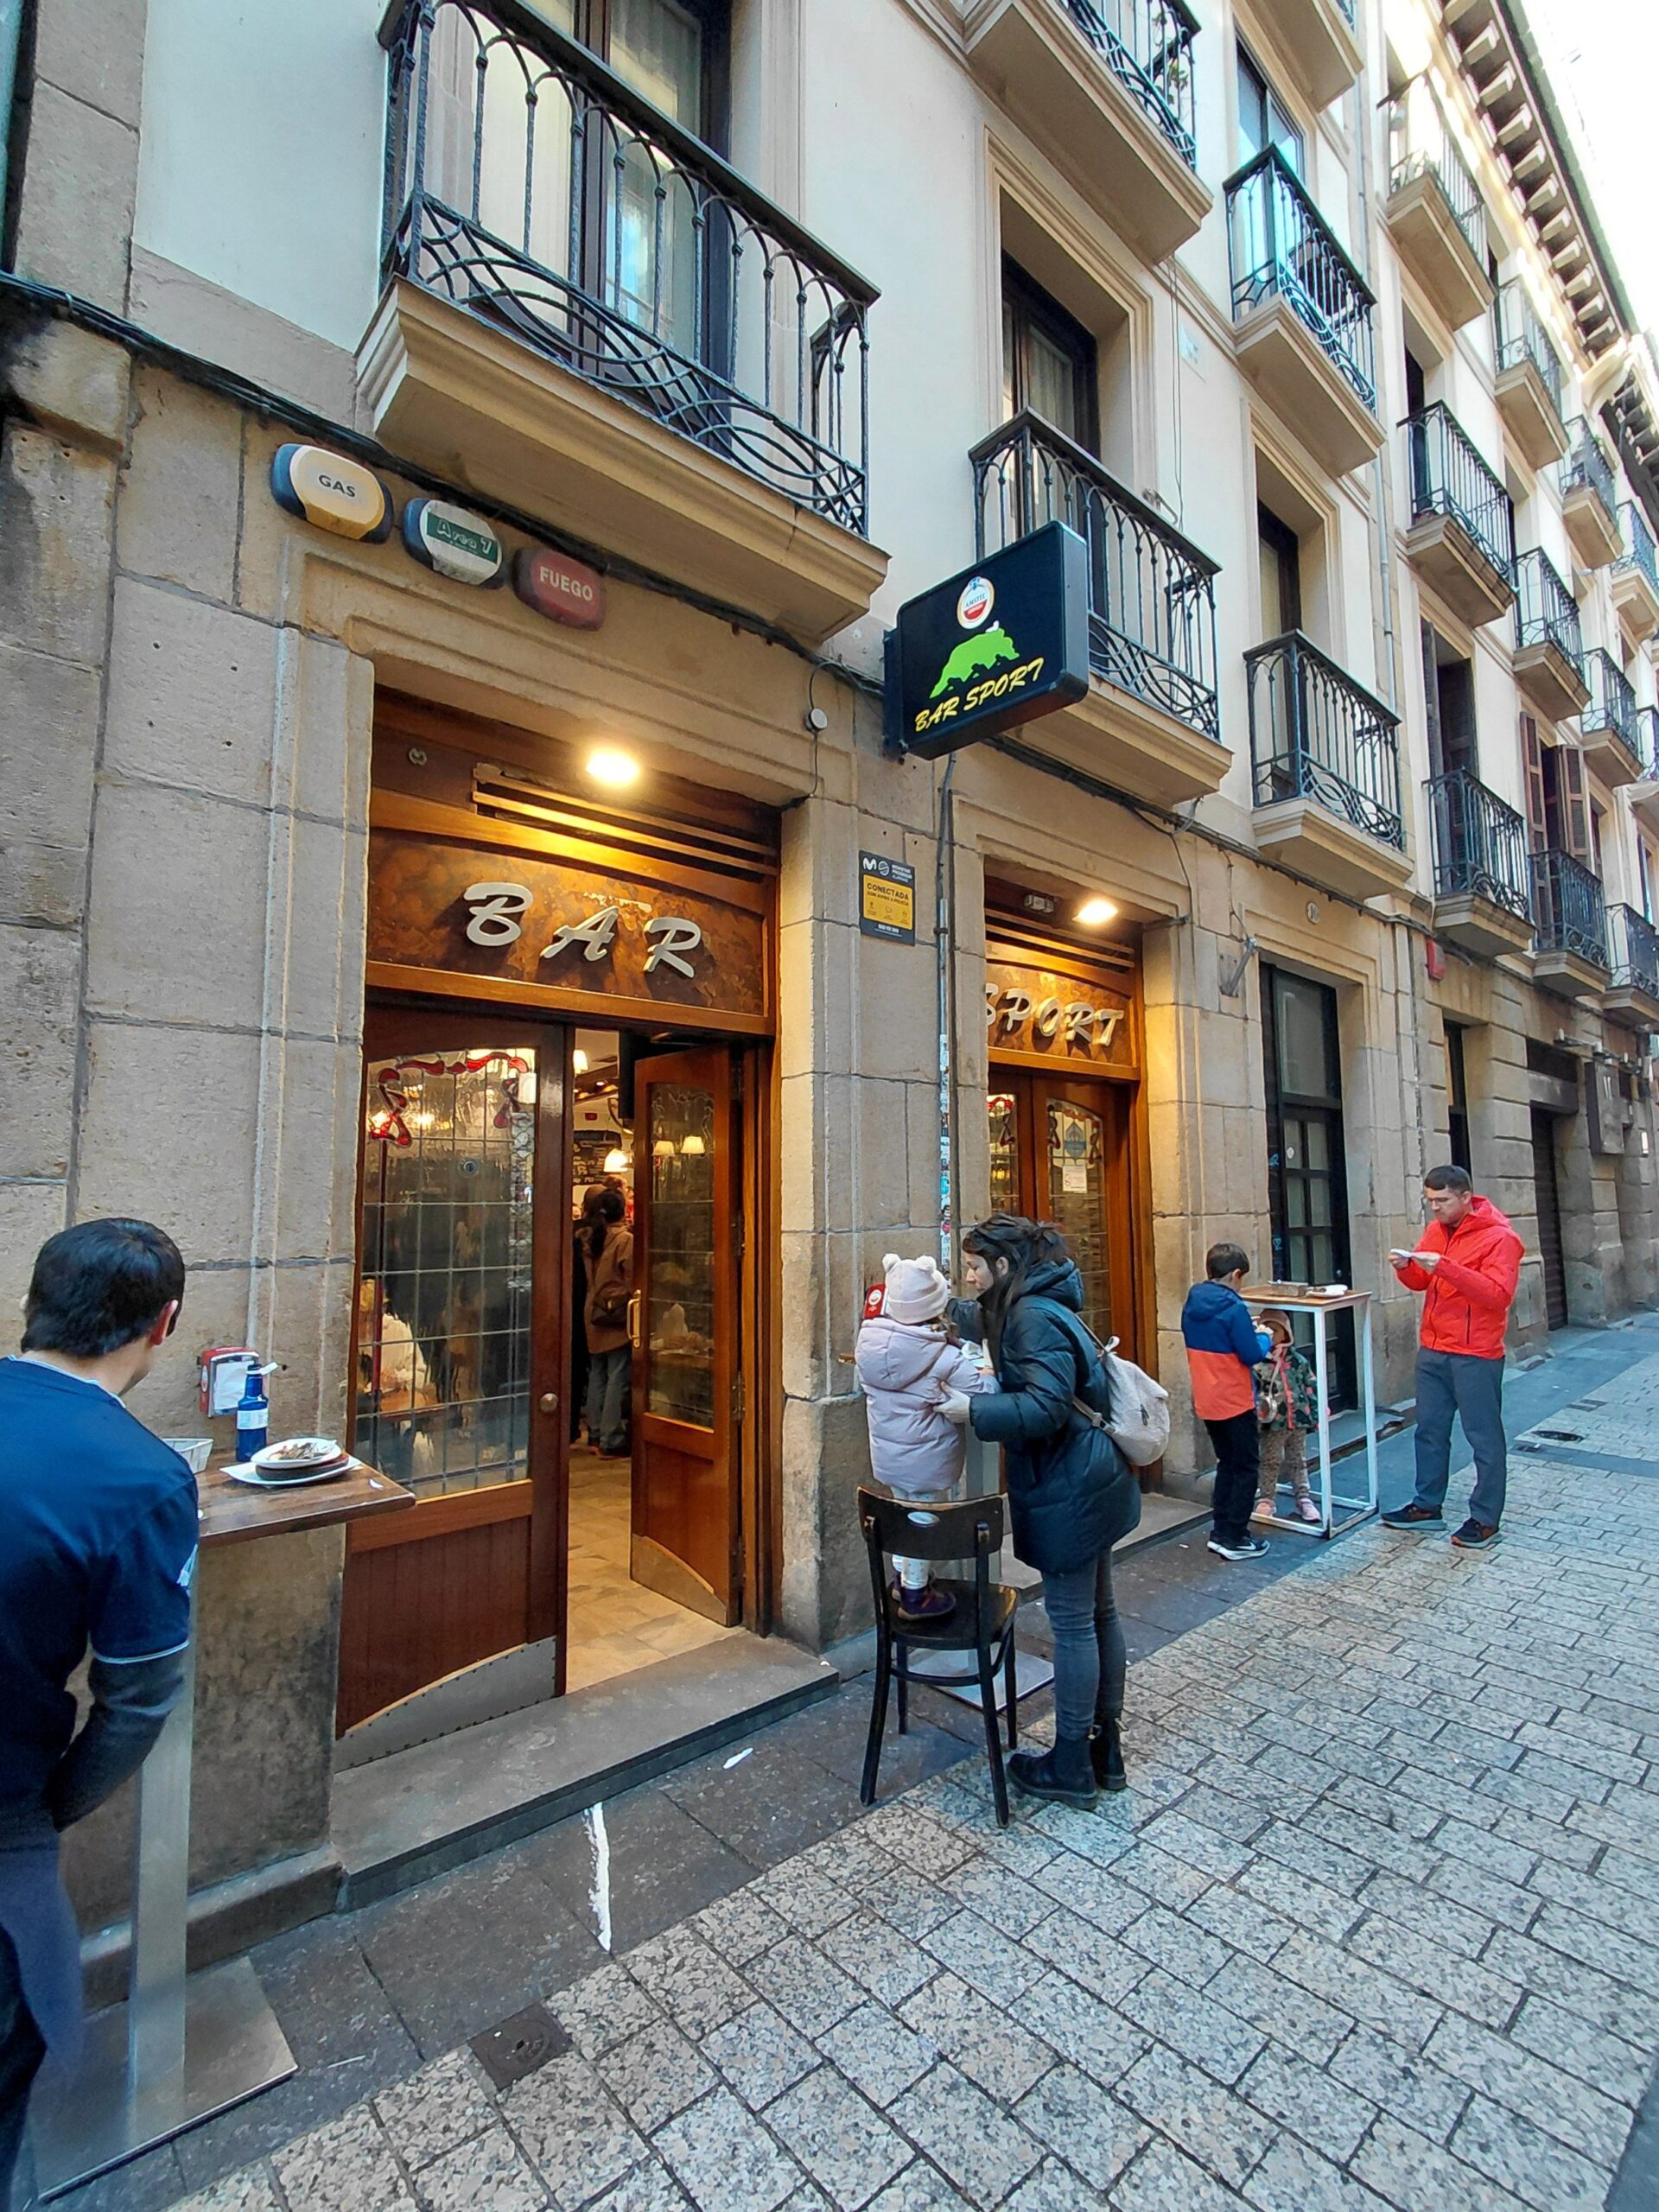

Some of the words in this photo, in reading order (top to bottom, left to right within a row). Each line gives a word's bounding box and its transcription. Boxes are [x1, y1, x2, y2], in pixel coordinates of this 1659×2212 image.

[318, 474, 357, 499] GAS
[436, 519, 477, 549] Area
[480, 537, 493, 555] 7
[539, 565, 594, 602] FUEGO
[914, 696, 960, 733] BAR
[963, 657, 1045, 711] SPORT
[867, 882, 909, 900] CONECTADA
[463, 881, 702, 978] BAR
[985, 982, 1124, 1047] SPORT
